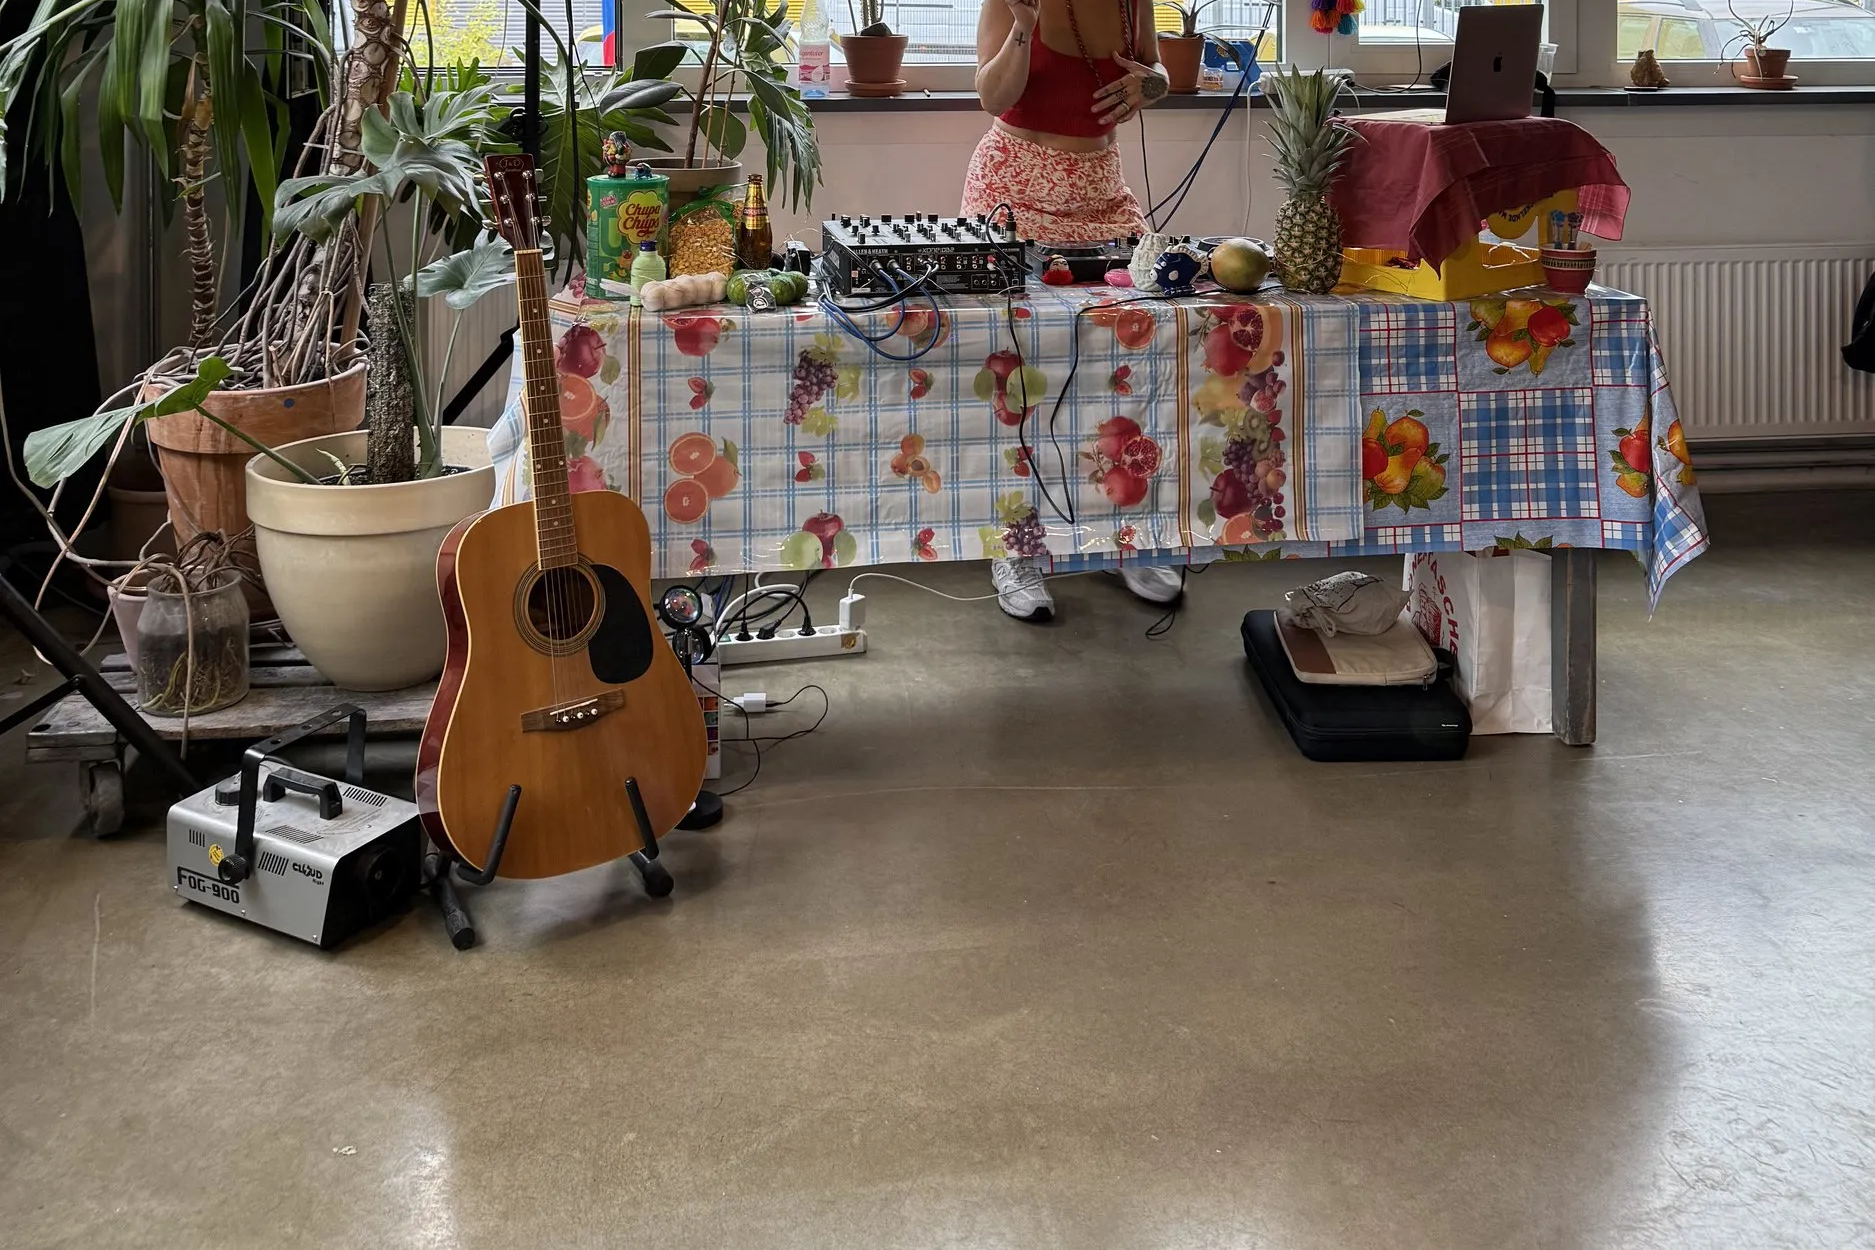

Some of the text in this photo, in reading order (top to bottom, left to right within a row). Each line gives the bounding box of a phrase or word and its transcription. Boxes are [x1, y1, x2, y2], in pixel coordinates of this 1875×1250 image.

[625, 203, 661, 218] Chupa
[623, 216, 660, 237] Chups
[177, 866, 240, 904] FOG-900
